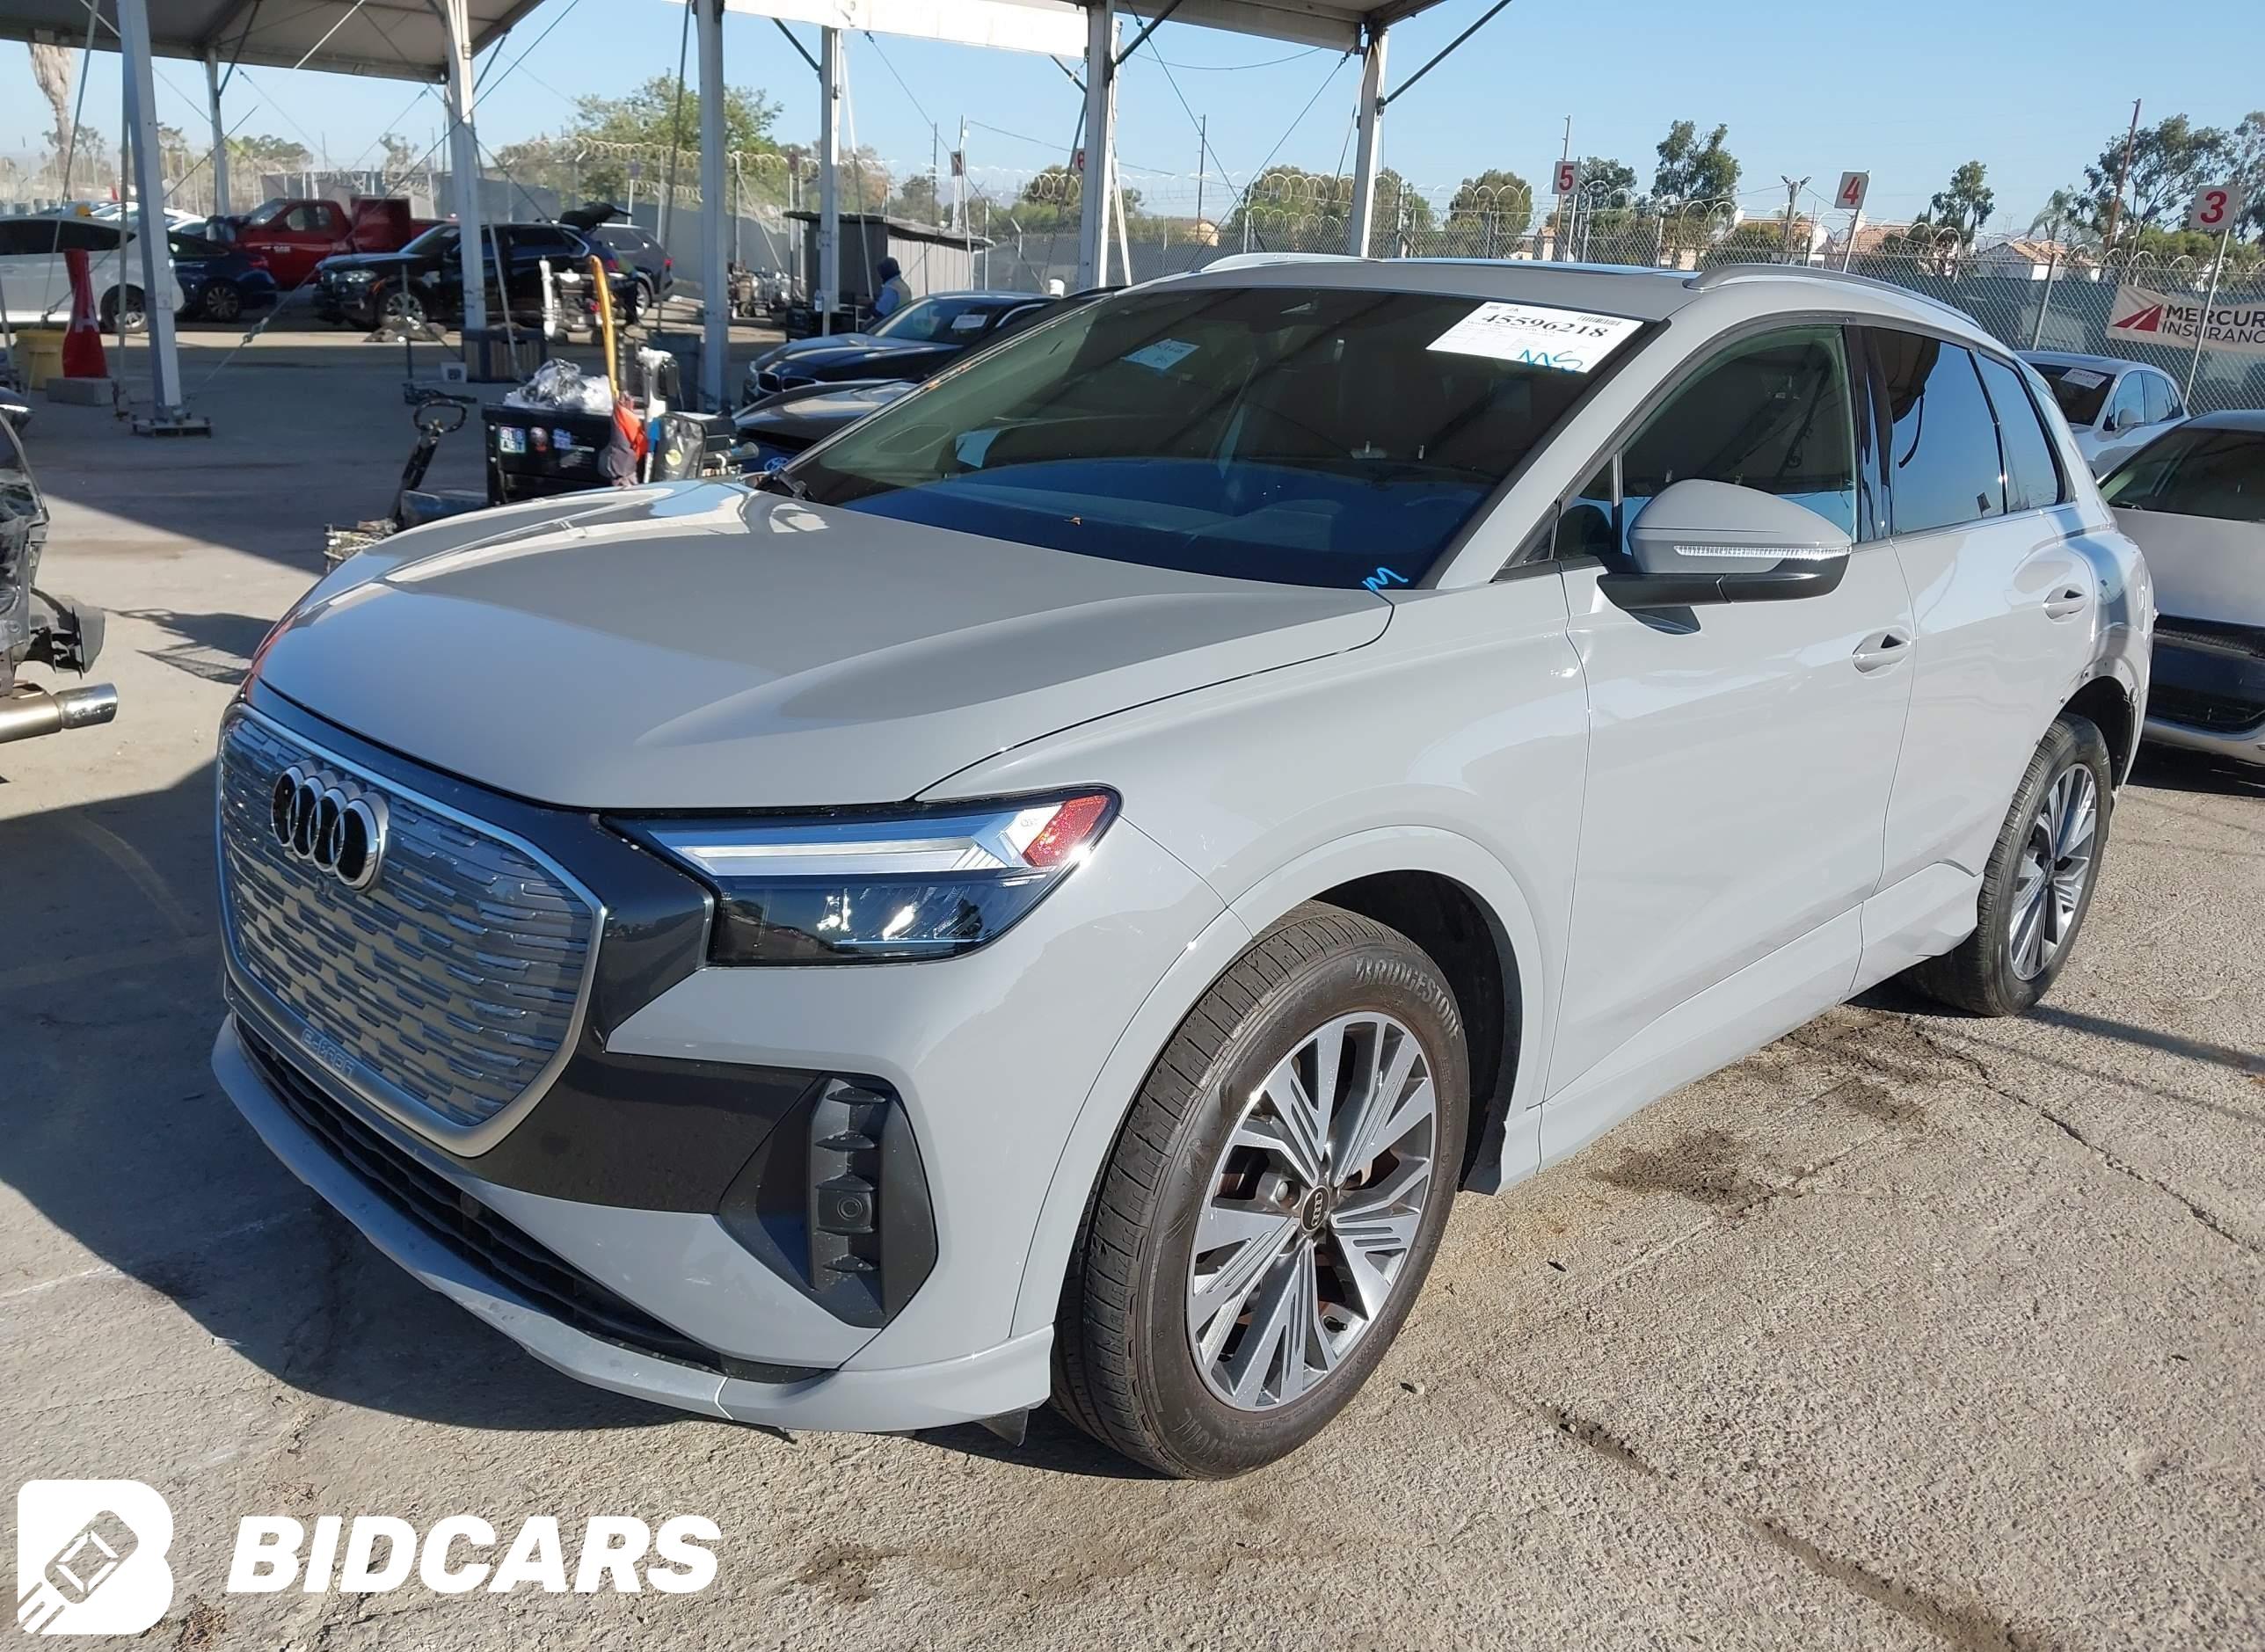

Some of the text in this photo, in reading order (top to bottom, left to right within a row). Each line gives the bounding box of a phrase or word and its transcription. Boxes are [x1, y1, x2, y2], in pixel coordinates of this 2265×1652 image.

[1559, 164, 1574, 191] 5
[1843, 176, 1861, 205] 4
[2200, 190, 2226, 223] 3
[1482, 314, 1609, 338] 45596218
